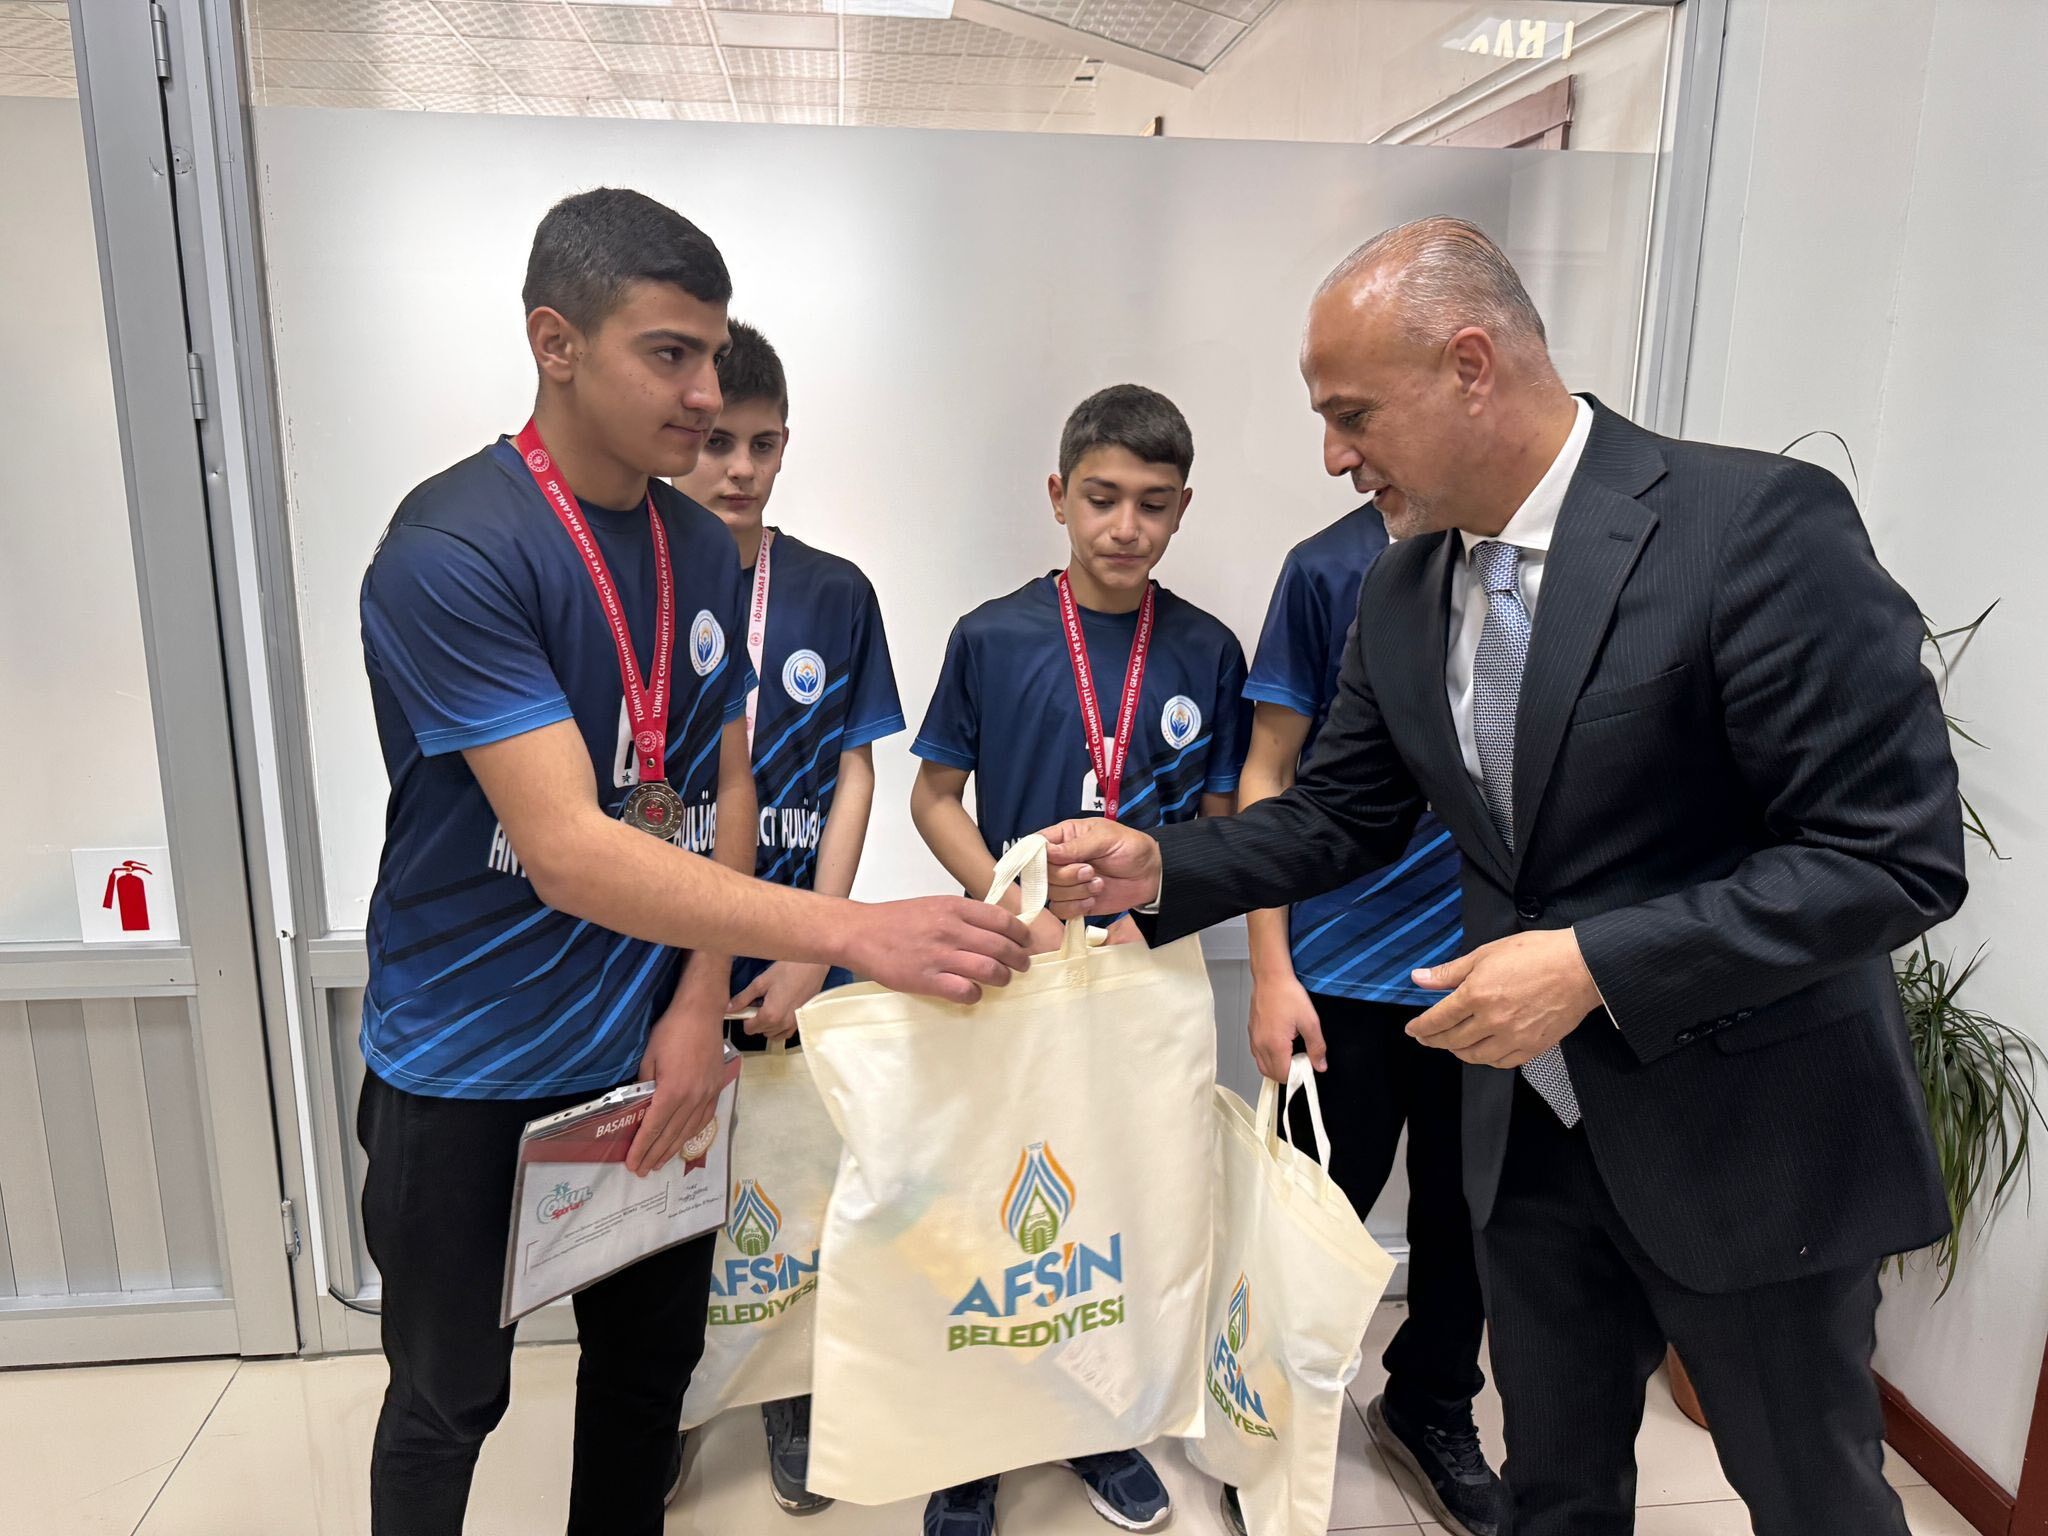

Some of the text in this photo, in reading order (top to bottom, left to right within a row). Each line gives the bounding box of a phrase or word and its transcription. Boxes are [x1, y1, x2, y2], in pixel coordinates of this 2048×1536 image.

[547, 480, 582, 532] BAKANLIĞI
[578, 532, 595, 560] SPOR
[591, 559, 602, 573] VE
[1069, 620, 1079, 641] SPOR
[1139, 623, 1148, 643] SPOR
[1073, 642, 1081, 652] VE
[1137, 644, 1144, 653] VE
